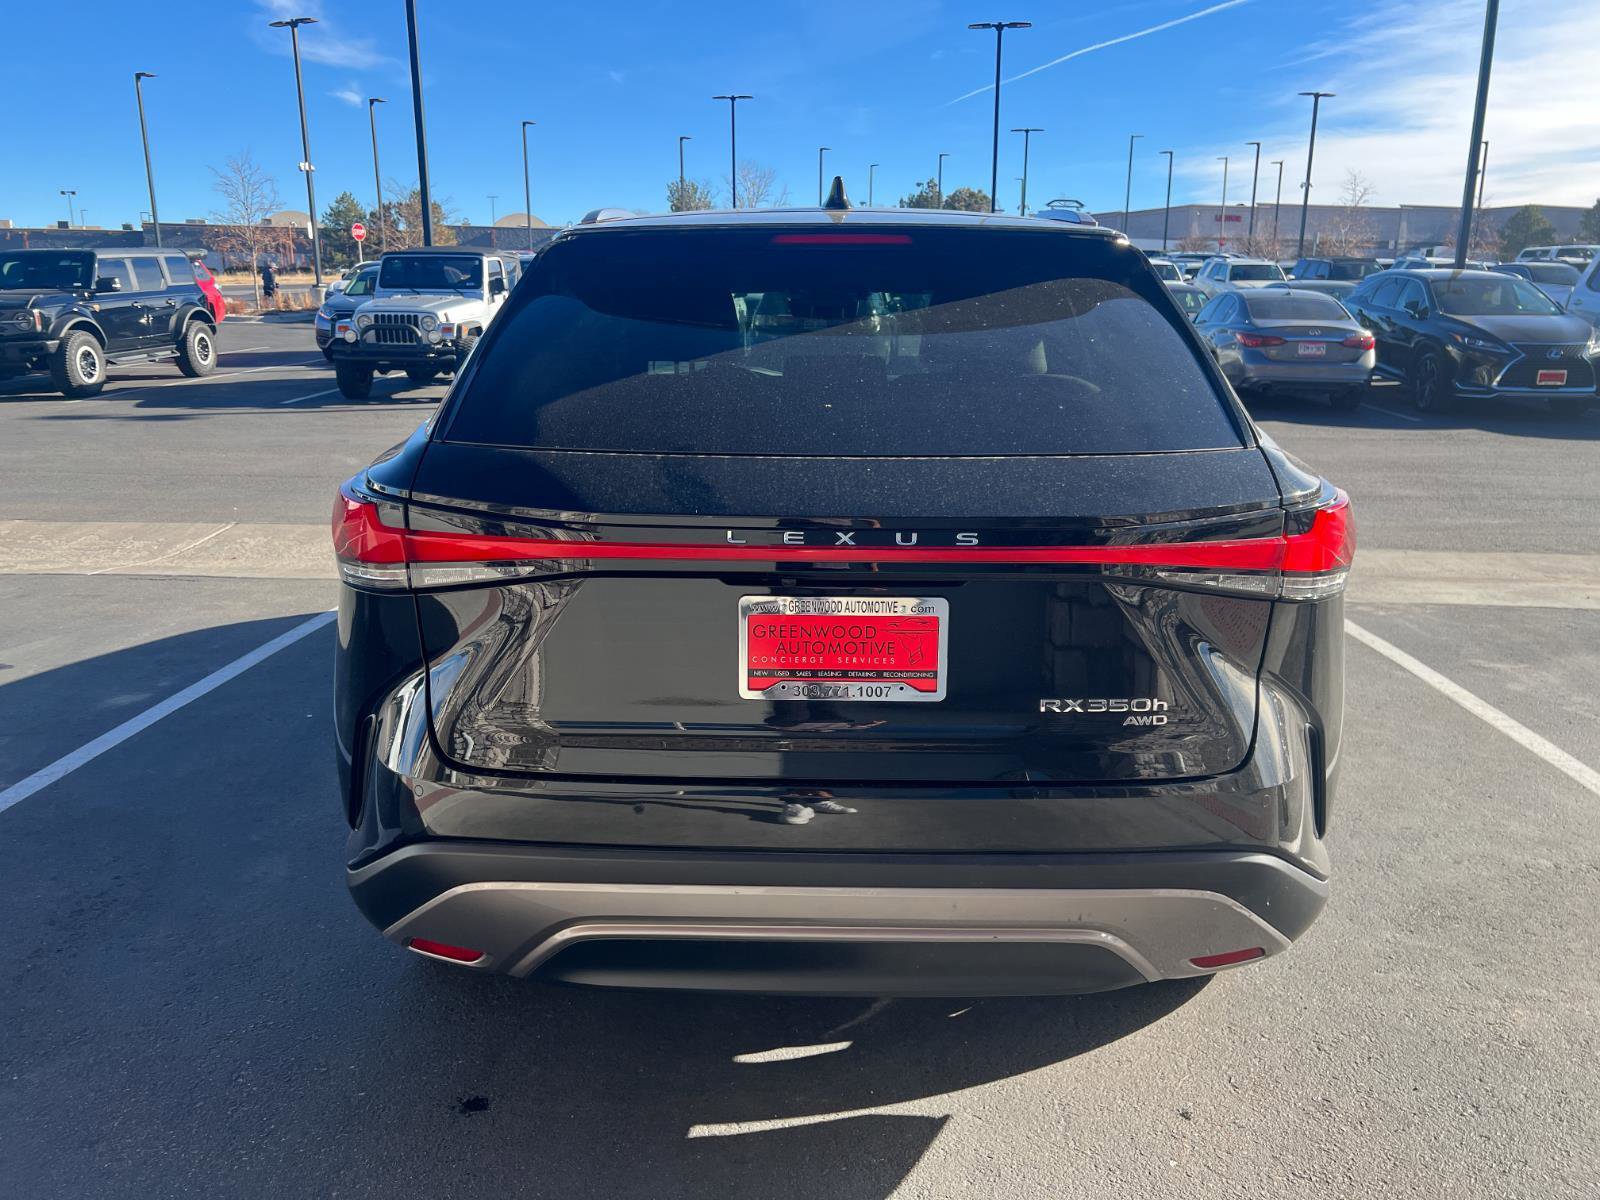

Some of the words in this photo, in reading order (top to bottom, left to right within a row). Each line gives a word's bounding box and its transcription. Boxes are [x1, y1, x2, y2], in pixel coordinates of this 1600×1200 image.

[726, 530, 979, 546] LEXUS
[788, 600, 843, 613] GREENWOOD
[845, 600, 899, 613] AUTOMOTIVE
[910, 605, 935, 613] com
[752, 624, 877, 639] GREENWOOD
[775, 640, 896, 655] AUTOMOTIVE
[752, 656, 824, 664] CONCIERGE
[837, 656, 895, 665] SERVICES
[793, 685, 892, 698] 303.771.1007
[1122, 714, 1168, 726] AWD
